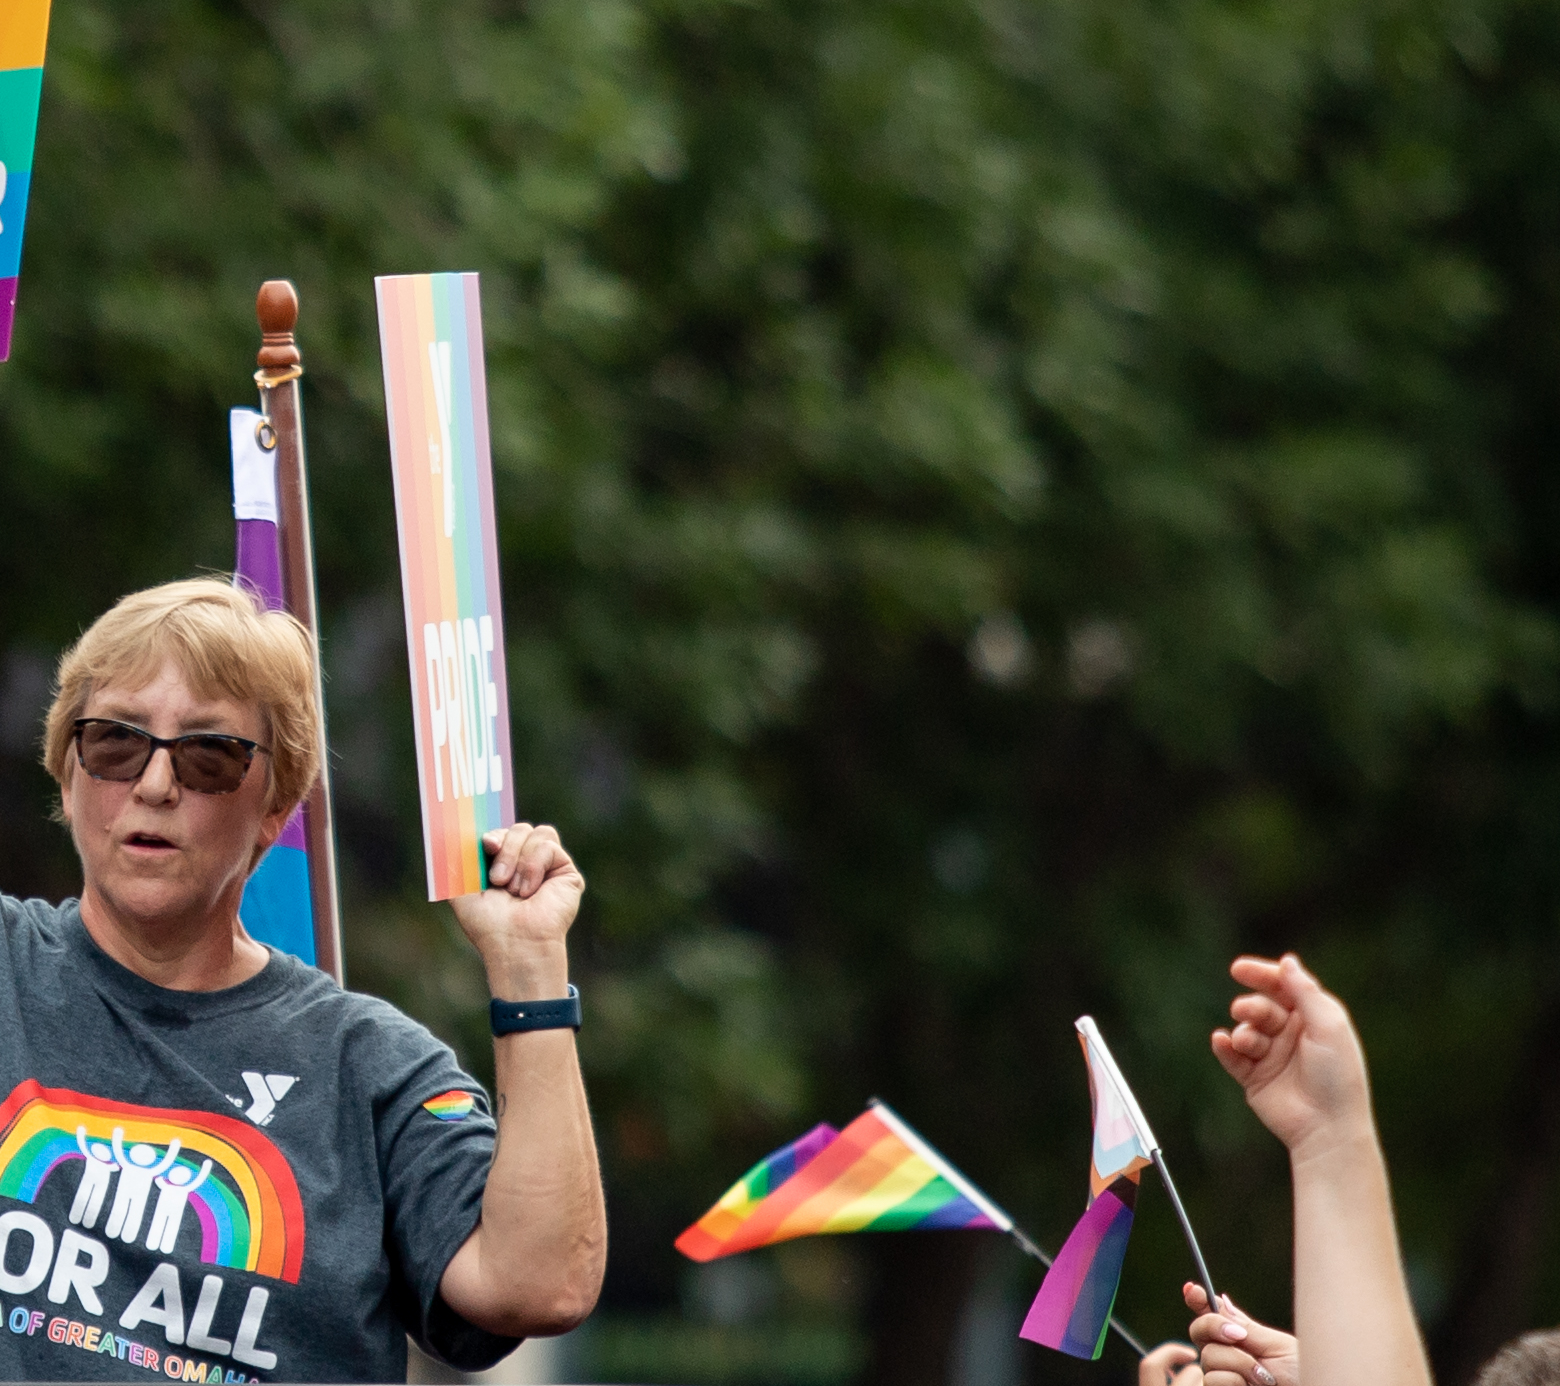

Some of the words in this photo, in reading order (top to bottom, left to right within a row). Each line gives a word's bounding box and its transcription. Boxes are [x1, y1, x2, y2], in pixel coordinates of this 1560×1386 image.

[423, 614, 503, 803] PRIDE
[8, 1306, 46, 1336] OF
[47, 1317, 161, 1372] GREATER
[118, 1263, 278, 1370] ALL
